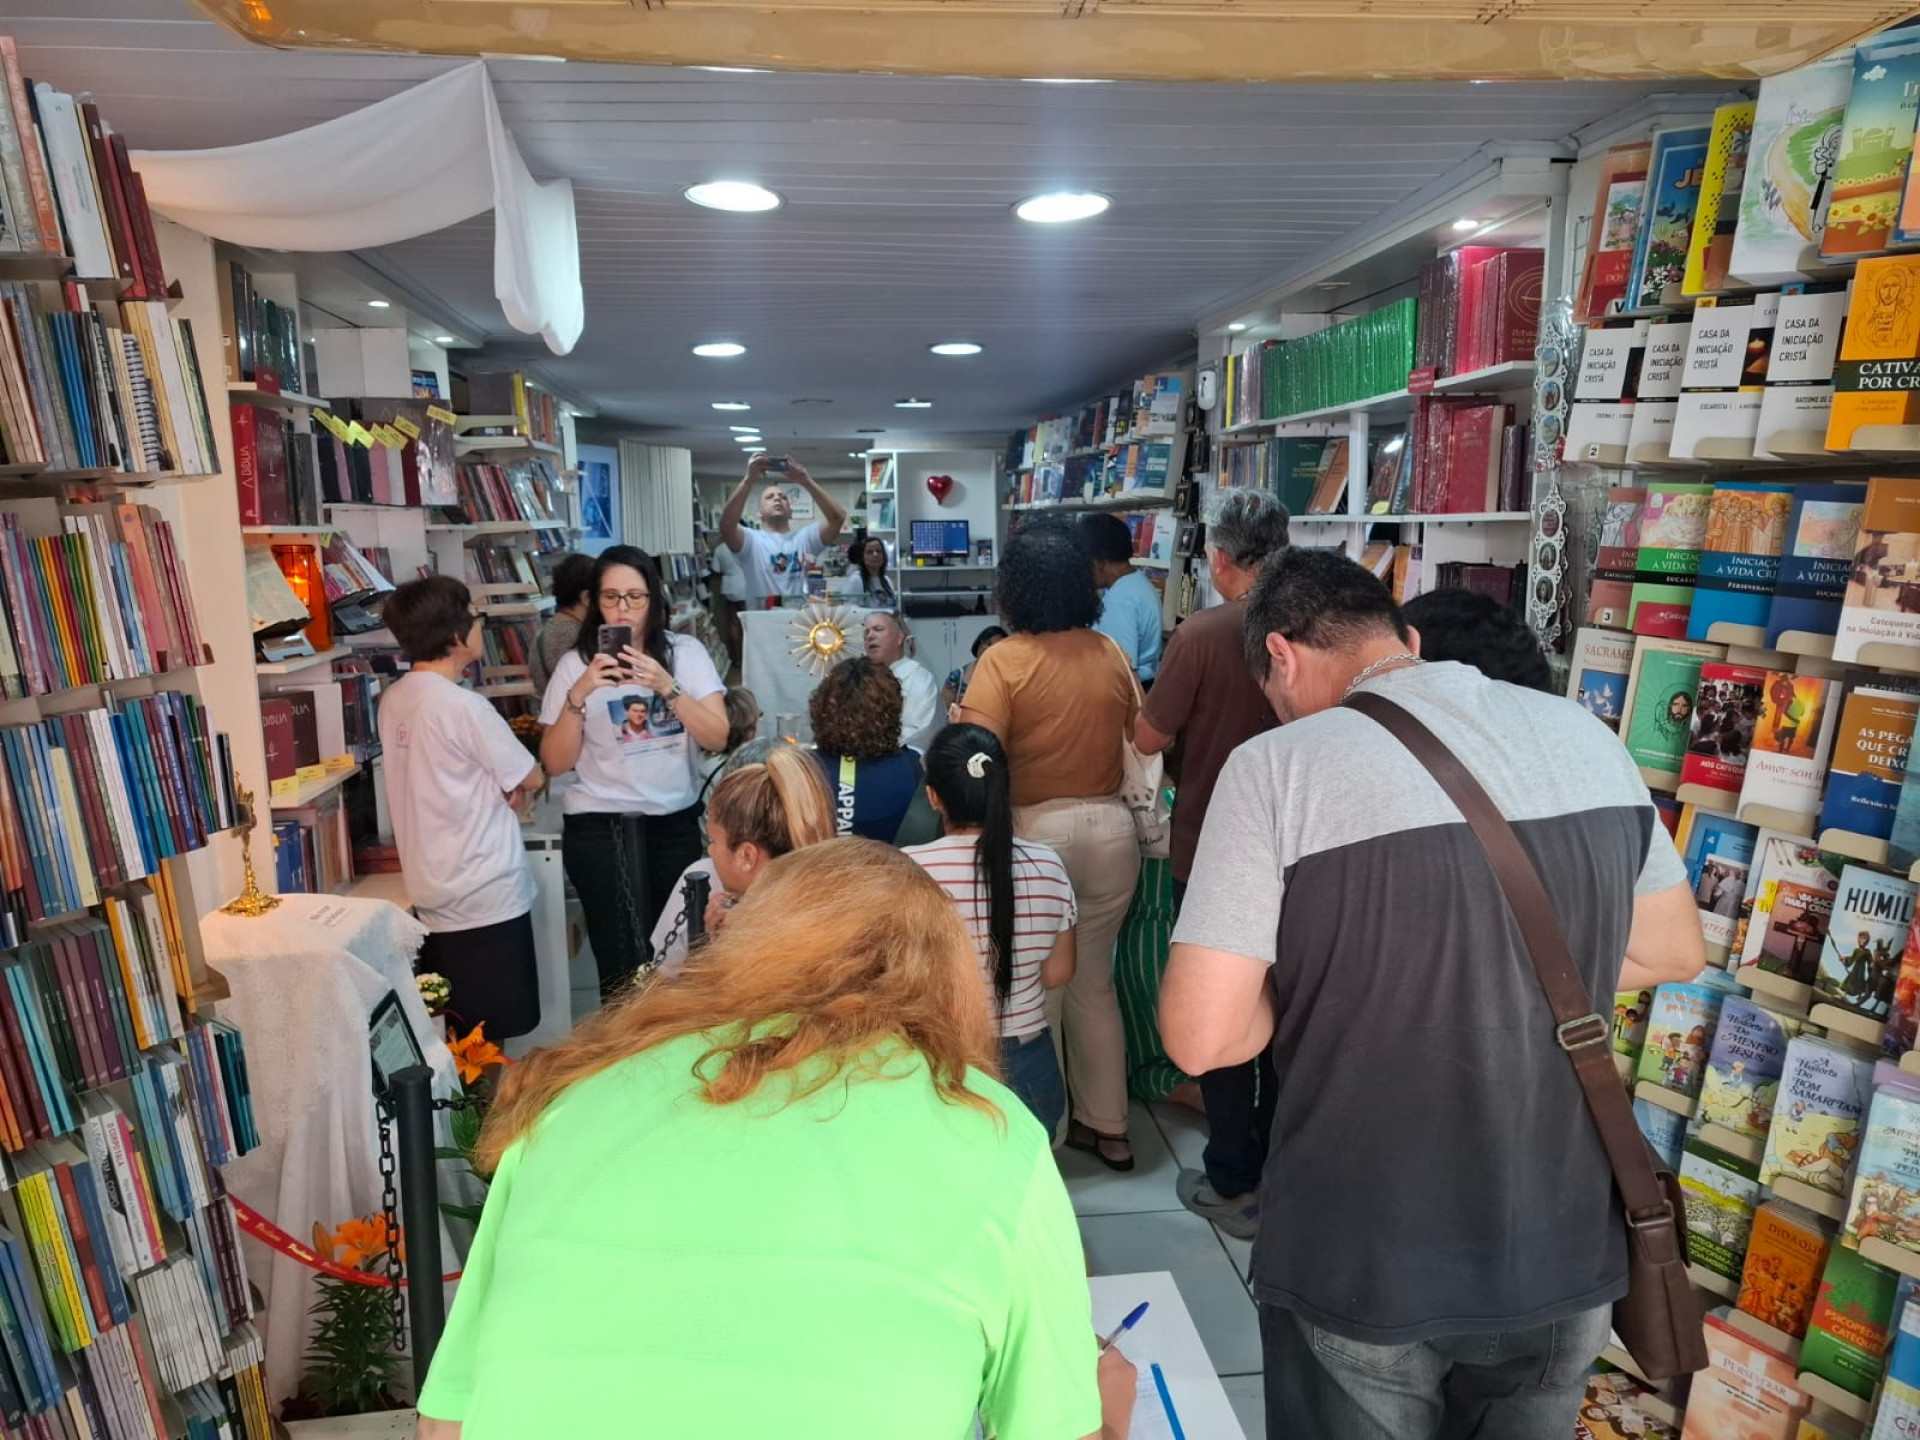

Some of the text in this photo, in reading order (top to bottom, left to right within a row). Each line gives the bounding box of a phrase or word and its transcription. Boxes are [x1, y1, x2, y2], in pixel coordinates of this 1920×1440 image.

[1785, 318, 1820, 329] CASA DA
[1698, 329, 1730, 339] CASA DA
[1781, 333, 1824, 347] INICIAÇÃO
[1605, 348, 1614, 356] DA
[1652, 343, 1680, 353] CASA DA
[1696, 343, 1734, 355] INICIAÇÃO
[1779, 349, 1808, 362] CRISTÃ
[1650, 356, 1683, 368] INICIAÇÃO
[1693, 358, 1719, 369] CRISTÃ
[1584, 373, 1605, 383] CRISTÃ
[1647, 370, 1671, 381] CRISTÃ
[1858, 376, 1893, 389] POR
[1590, 447, 1598, 456] 2
[1661, 561, 1687, 571] VIDA
[1726, 566, 1754, 576] VIDA
[1807, 572, 1837, 583] VIDA
[1603, 612, 1611, 622] 3
[1870, 617, 1914, 629] Catequese
[1858, 727, 1875, 738] AS
[1856, 739, 1885, 752] QUE
[1756, 760, 1787, 776] Amor
[1791, 767, 1812, 779] sem
[1844, 887, 1910, 923] HUMIL
[1728, 1044, 1766, 1062] JESUS
[1796, 1066, 1813, 1079] Do
[1792, 1077, 1822, 1093] BOM
